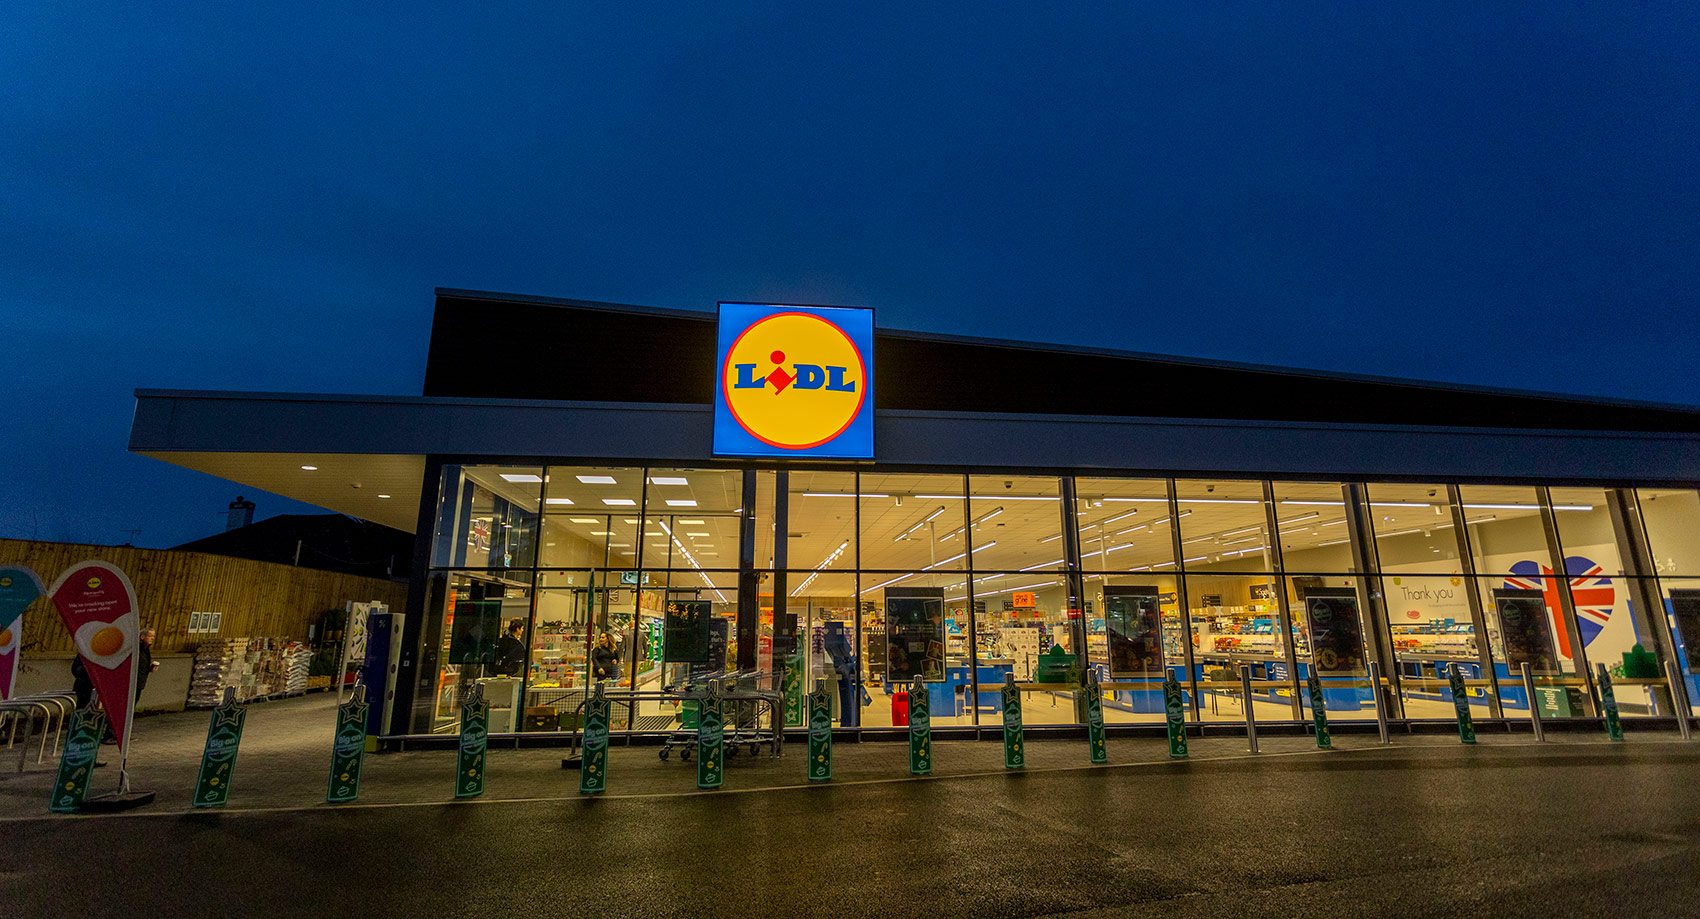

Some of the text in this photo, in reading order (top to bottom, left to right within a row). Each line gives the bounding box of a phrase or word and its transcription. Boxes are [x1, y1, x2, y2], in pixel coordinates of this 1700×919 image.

[1401, 585, 1453, 603] Thank you
[210, 739, 224, 748] Big
[338, 736, 350, 745] Big
